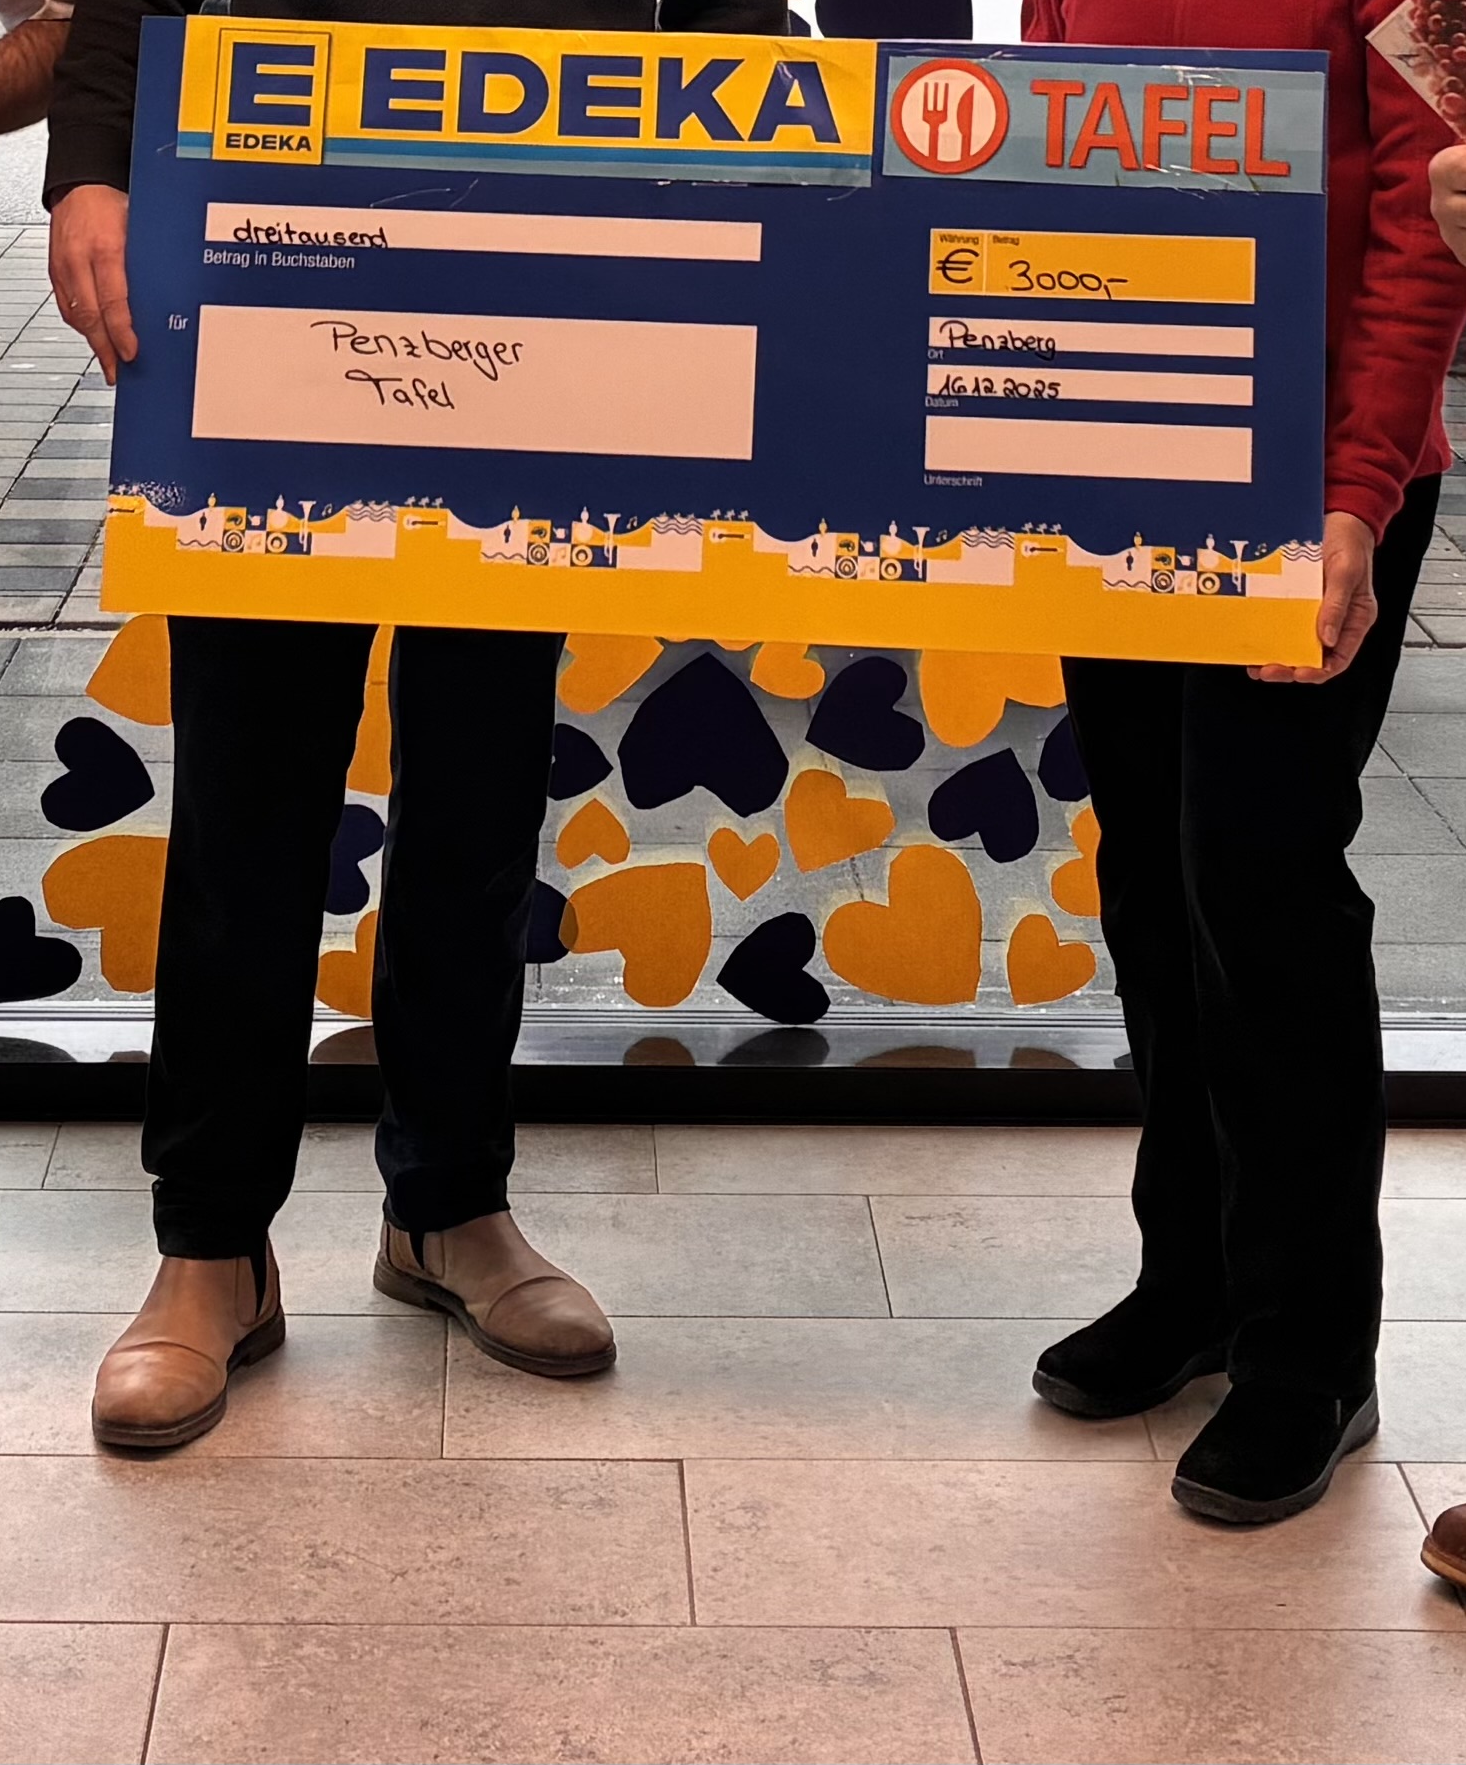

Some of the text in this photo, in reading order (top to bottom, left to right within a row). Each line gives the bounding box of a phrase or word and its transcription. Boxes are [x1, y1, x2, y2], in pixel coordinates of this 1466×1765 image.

[227, 42, 316, 126] E
[360, 47, 842, 144] EDEKA
[225, 133, 312, 152] EDEKA
[1031, 79, 1291, 176] TAFEL
[233, 219, 388, 248] dreitausend
[203, 249, 355, 269] Betrag in Buchstaben
[936, 248, 979, 283] €
[168, 314, 189, 330] für
[310, 320, 523, 381] Penzberger
[927, 349, 944, 359] Ort
[939, 320, 1056, 361] Penzberg
[345, 369, 455, 410] Tafel
[925, 396, 959, 407] Datum
[924, 474, 983, 486] Unterschrift
